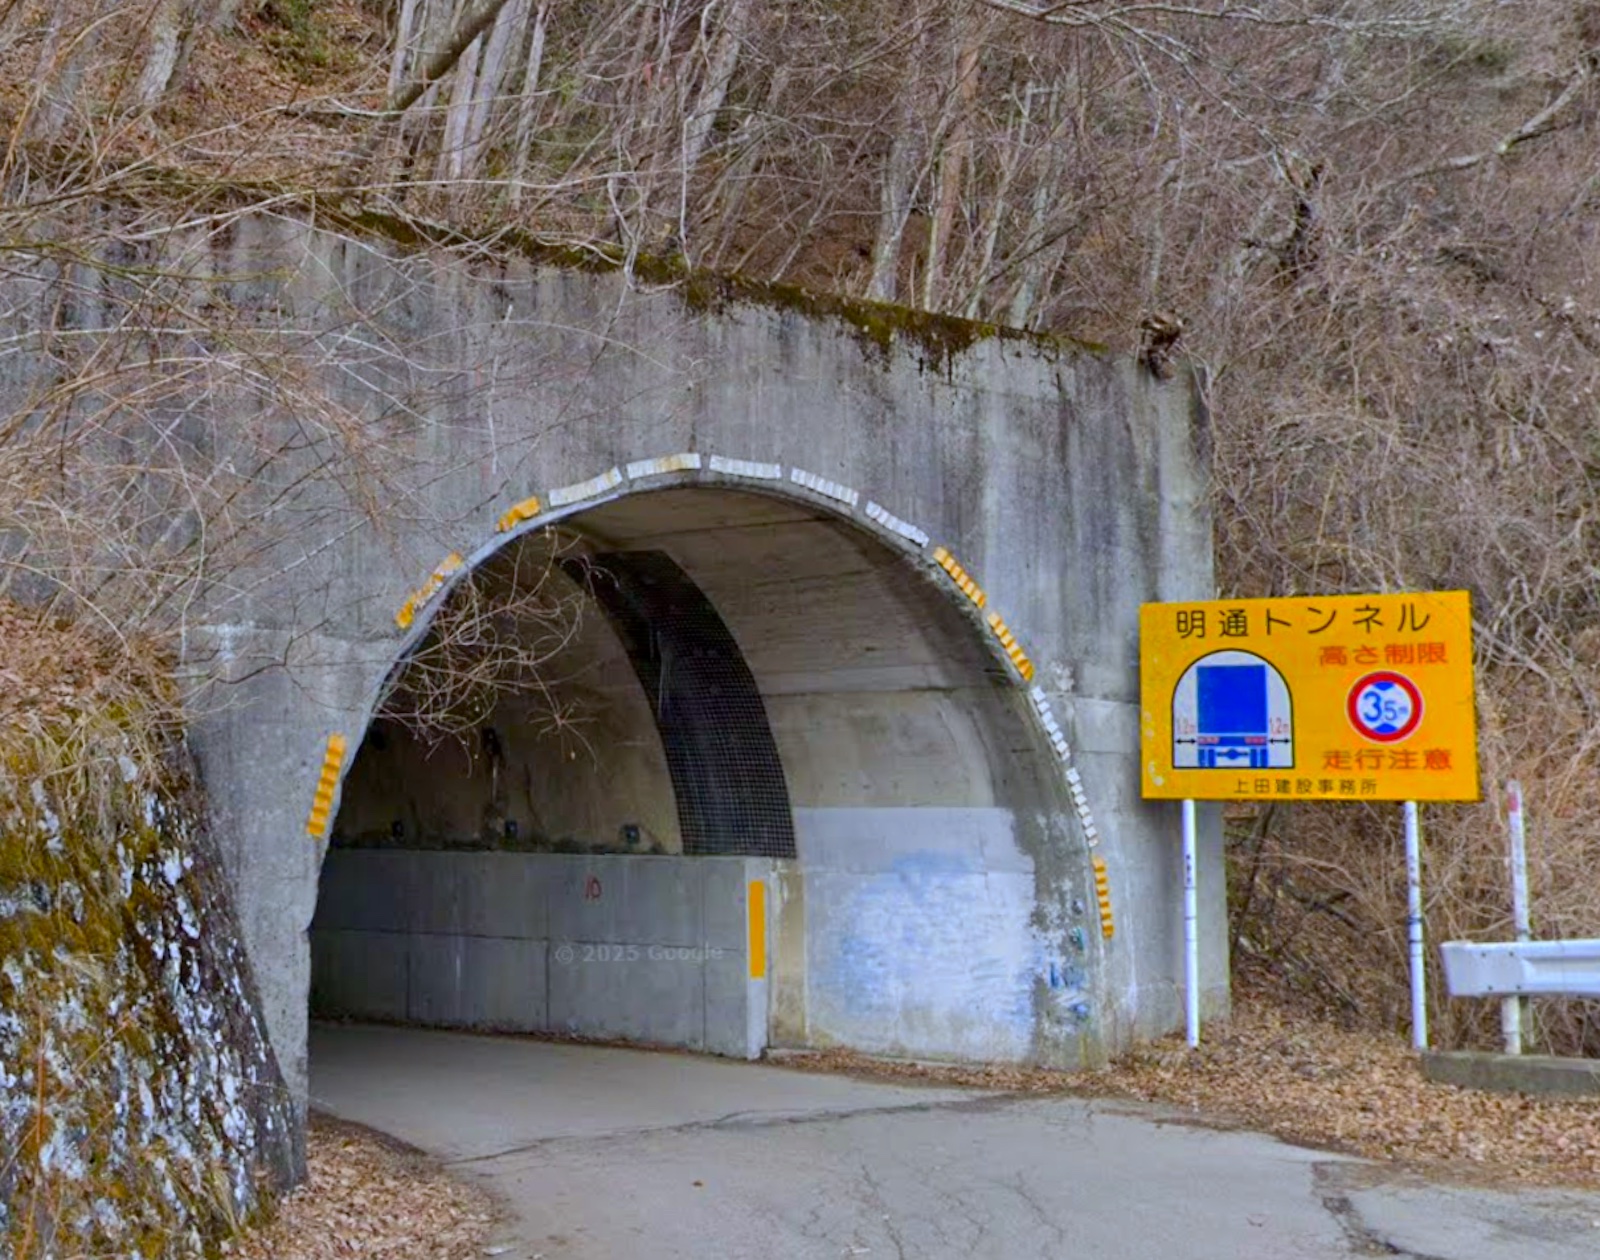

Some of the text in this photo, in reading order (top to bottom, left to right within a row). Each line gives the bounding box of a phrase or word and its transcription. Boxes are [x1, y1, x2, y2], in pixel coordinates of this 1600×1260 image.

[1176, 604, 1430, 639] 明通トンネル
[1319, 643, 1448, 667] 高さ制限
[1322, 749, 1452, 770] 走行注意
[1234, 778, 1378, 794] 上田建設事務所
